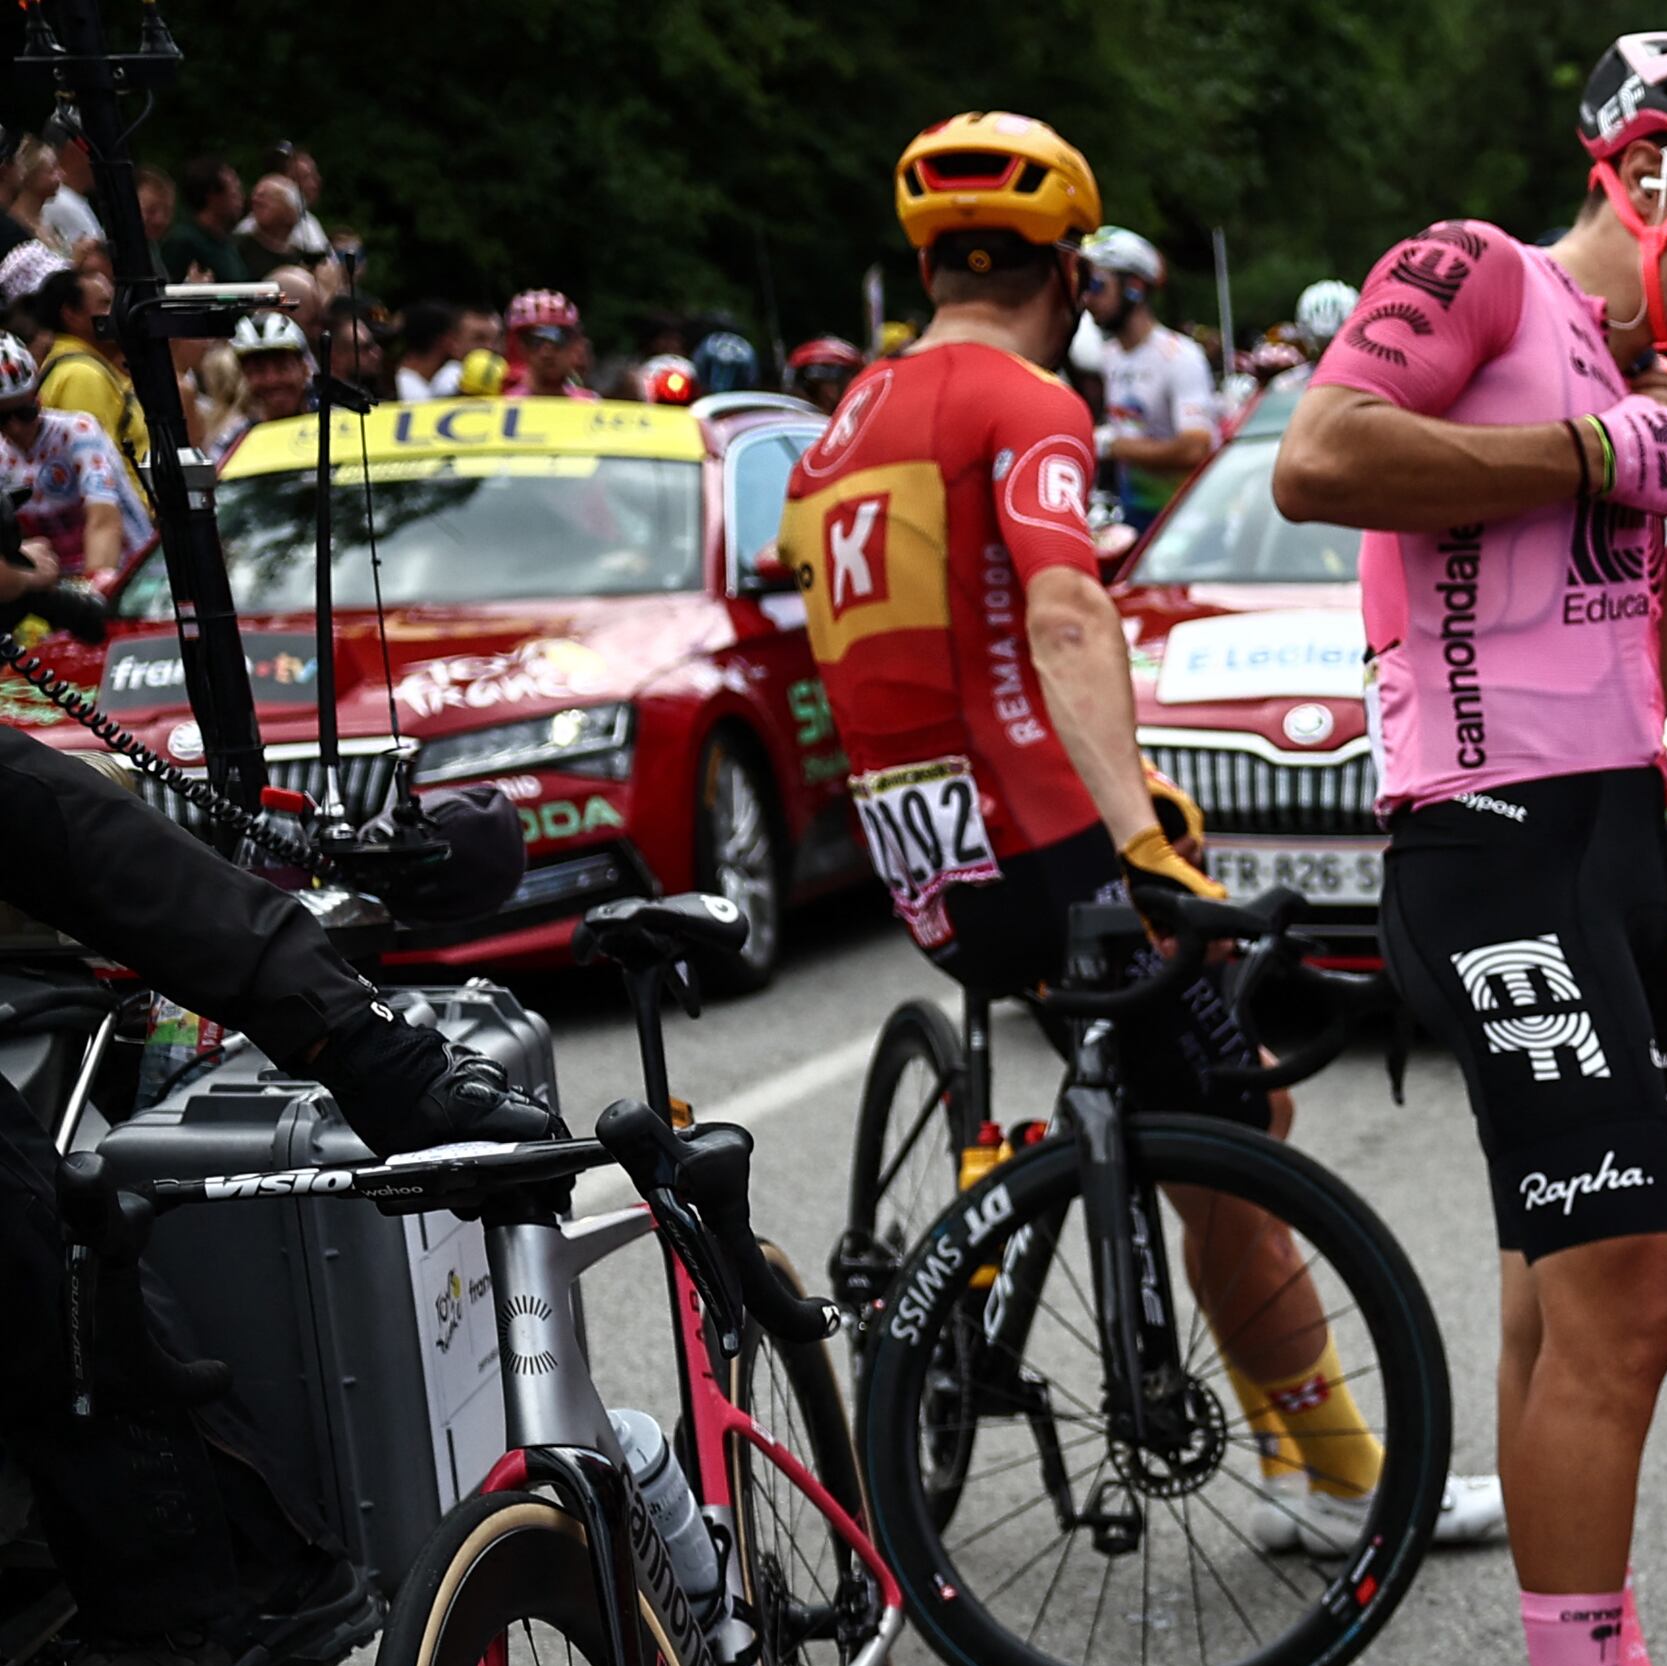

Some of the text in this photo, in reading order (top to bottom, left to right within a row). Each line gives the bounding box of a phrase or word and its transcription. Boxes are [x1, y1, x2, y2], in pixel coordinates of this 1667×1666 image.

[394, 405, 547, 444] LCL
[1562, 590, 1650, 626] Educa
[988, 635, 1046, 746] REMA
[204, 1168, 352, 1199] VISIO
[362, 1182, 424, 1198] wahoo
[963, 1182, 1013, 1246] DT
[891, 1233, 963, 1346] SWISS
